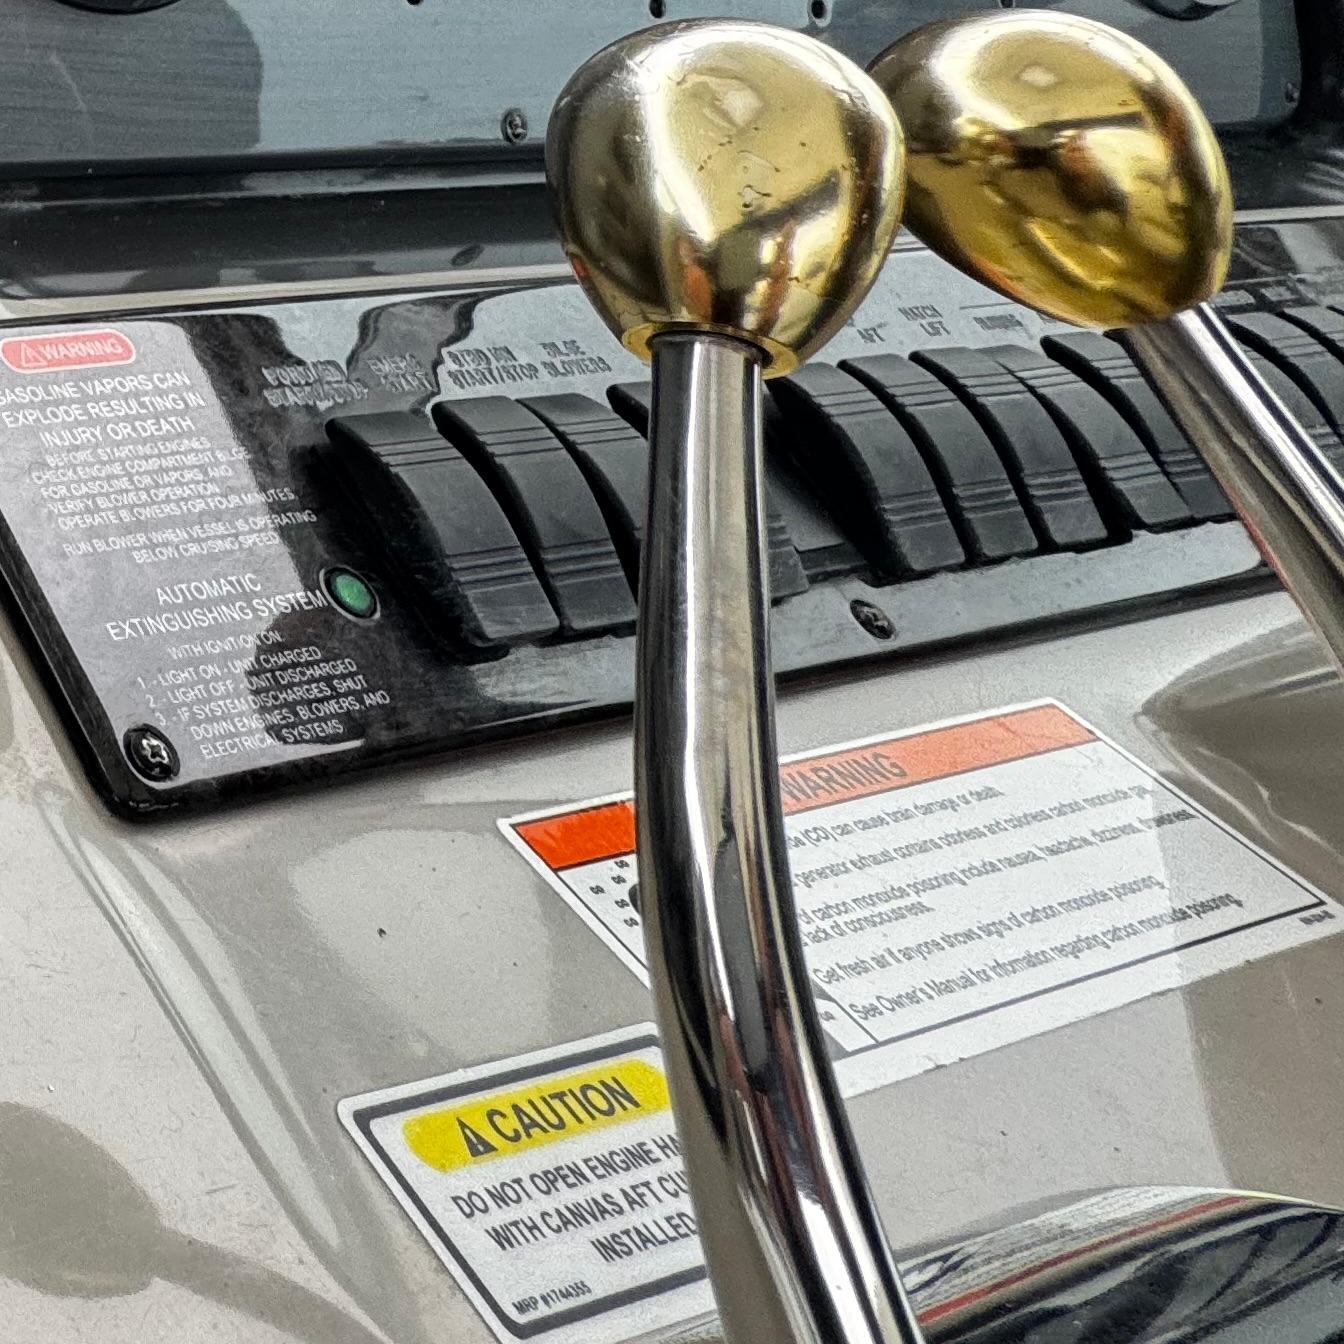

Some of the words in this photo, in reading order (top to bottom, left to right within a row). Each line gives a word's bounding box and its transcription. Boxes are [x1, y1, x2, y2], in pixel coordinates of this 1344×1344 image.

[39, 338, 124, 362] WARNING
[80, 374, 153, 398] VAPORS
[153, 371, 192, 389] CAN
[1, 403, 89, 429] EXPLODE
[87, 393, 185, 419] RESULTING
[185, 391, 207, 408] IN
[39, 424, 104, 449] INJURY
[106, 422, 136, 441] OR
[135, 414, 196, 438] DEATH
[31, 468, 76, 486] CHECK
[76, 462, 125, 481] ENGINE
[125, 451, 214, 474] COMPARTMENT
[97, 442, 160, 462] STARTING
[39, 484, 71, 500] FOR
[70, 477, 134, 497] GASOLINE
[134, 474, 155, 489] OR
[48, 497, 96, 515] VERIFY
[96, 490, 151, 510] BLOWER
[58, 512, 118, 532] OPERATE
[119, 502, 182, 524] BLOWERS
[182, 499, 209, 514] FOR
[208, 495, 241, 510] FOUR
[63, 541, 92, 557] RUN
[93, 533, 148, 554] BLOWER
[149, 528, 190, 546] WHEN
[187, 522, 237, 540] VESSEL
[234, 518, 250, 533] IS
[248, 509, 318, 531] OPERATING
[132, 546, 180, 565] BELOW
[179, 539, 240, 558] CRUISING
[155, 572, 262, 606] AUTOMATIC
[105, 601, 253, 642] EXTINGUISHING
[252, 589, 329, 617] SYSTEM
[168, 642, 206, 660] WITH
[204, 632, 259, 653] IGNITION
[160, 668, 197, 687] LIGHT
[198, 663, 221, 679] ON
[229, 658, 257, 675] UNIT
[259, 646, 322, 668] CHARGED
[167, 686, 207, 705] LIGHT
[209, 680, 235, 698] OFF
[244, 674, 274, 692] UNIT
[277, 657, 357, 685] DISCHARGED
[178, 708, 191, 723] IF
[191, 699, 251, 720] SYSTEM
[336, 674, 369, 695] SHUT
[190, 721, 235, 741] DOWN
[364, 690, 391, 707] AND
[199, 734, 283, 760] ELECTRICAL
[781, 751, 908, 803] WARNING
[800, 825, 839, 848] (CO)
[831, 823, 857, 837] can
[811, 900, 857, 923] carbon
[812, 963, 845, 985] Get
[838, 956, 873, 979] fresh
[870, 947, 893, 970] air
[885, 947, 902, 965] if
[897, 937, 945, 961] anyone
[941, 927, 982, 949] shows
[1007, 911, 1025, 929] of
[848, 1002, 884, 1022] See
[875, 981, 935, 1013] Owner's
[930, 968, 978, 998] Manual
[972, 967, 995, 985] for
[485, 1075, 641, 1144] CAUTION
[451, 1190, 490, 1219] DO
[484, 1177, 533, 1209] NOT
[529, 1161, 591, 1196] OPEN
[587, 1141, 662, 1181] ENGINE
[484, 1215, 547, 1252] WITH
[540, 1191, 625, 1235] CANVAS
[620, 1180, 663, 1213] AFT
[590, 1210, 699, 1263] INSTALLED
